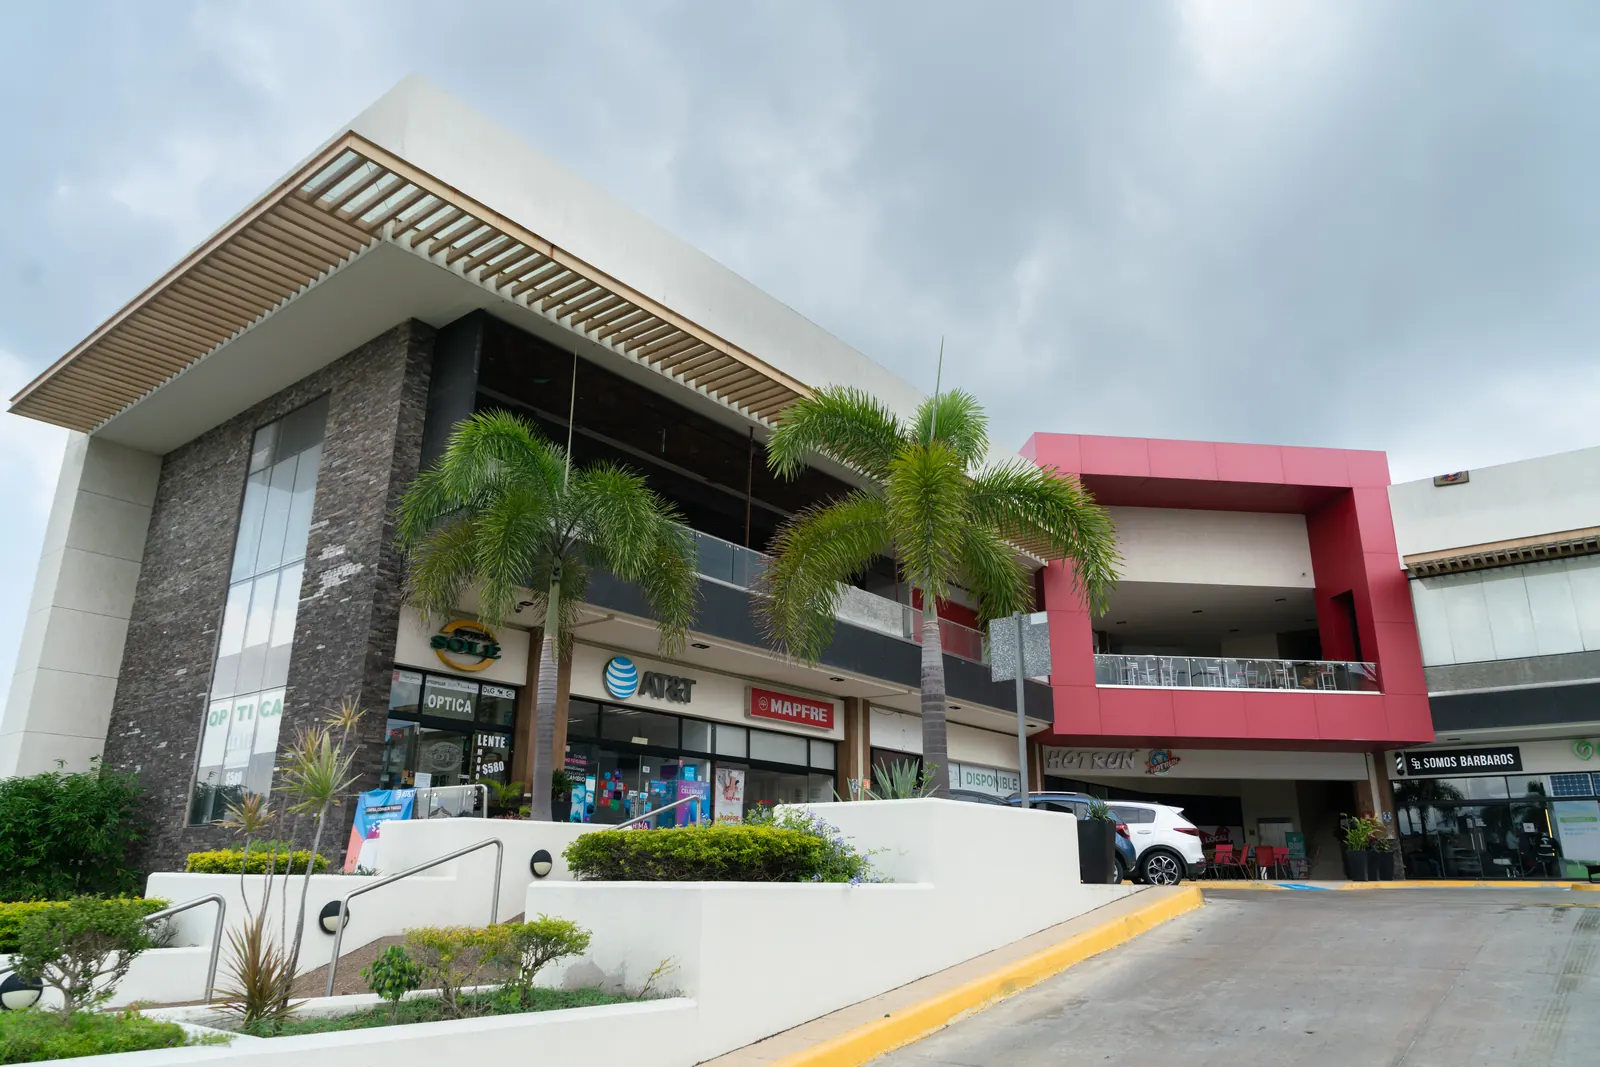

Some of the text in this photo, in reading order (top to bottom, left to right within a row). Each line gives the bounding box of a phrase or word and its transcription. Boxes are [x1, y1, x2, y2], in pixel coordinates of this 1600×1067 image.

[638, 671, 697, 703] AT&T
[427, 694, 472, 714] OPTICA
[770, 698, 828, 723] MAPFRE
[477, 734, 506, 748] LENTE
[482, 761, 505, 775] $580
[1423, 756, 1457, 769] SOMOS
[966, 771, 1018, 791] DISPONIBLE
